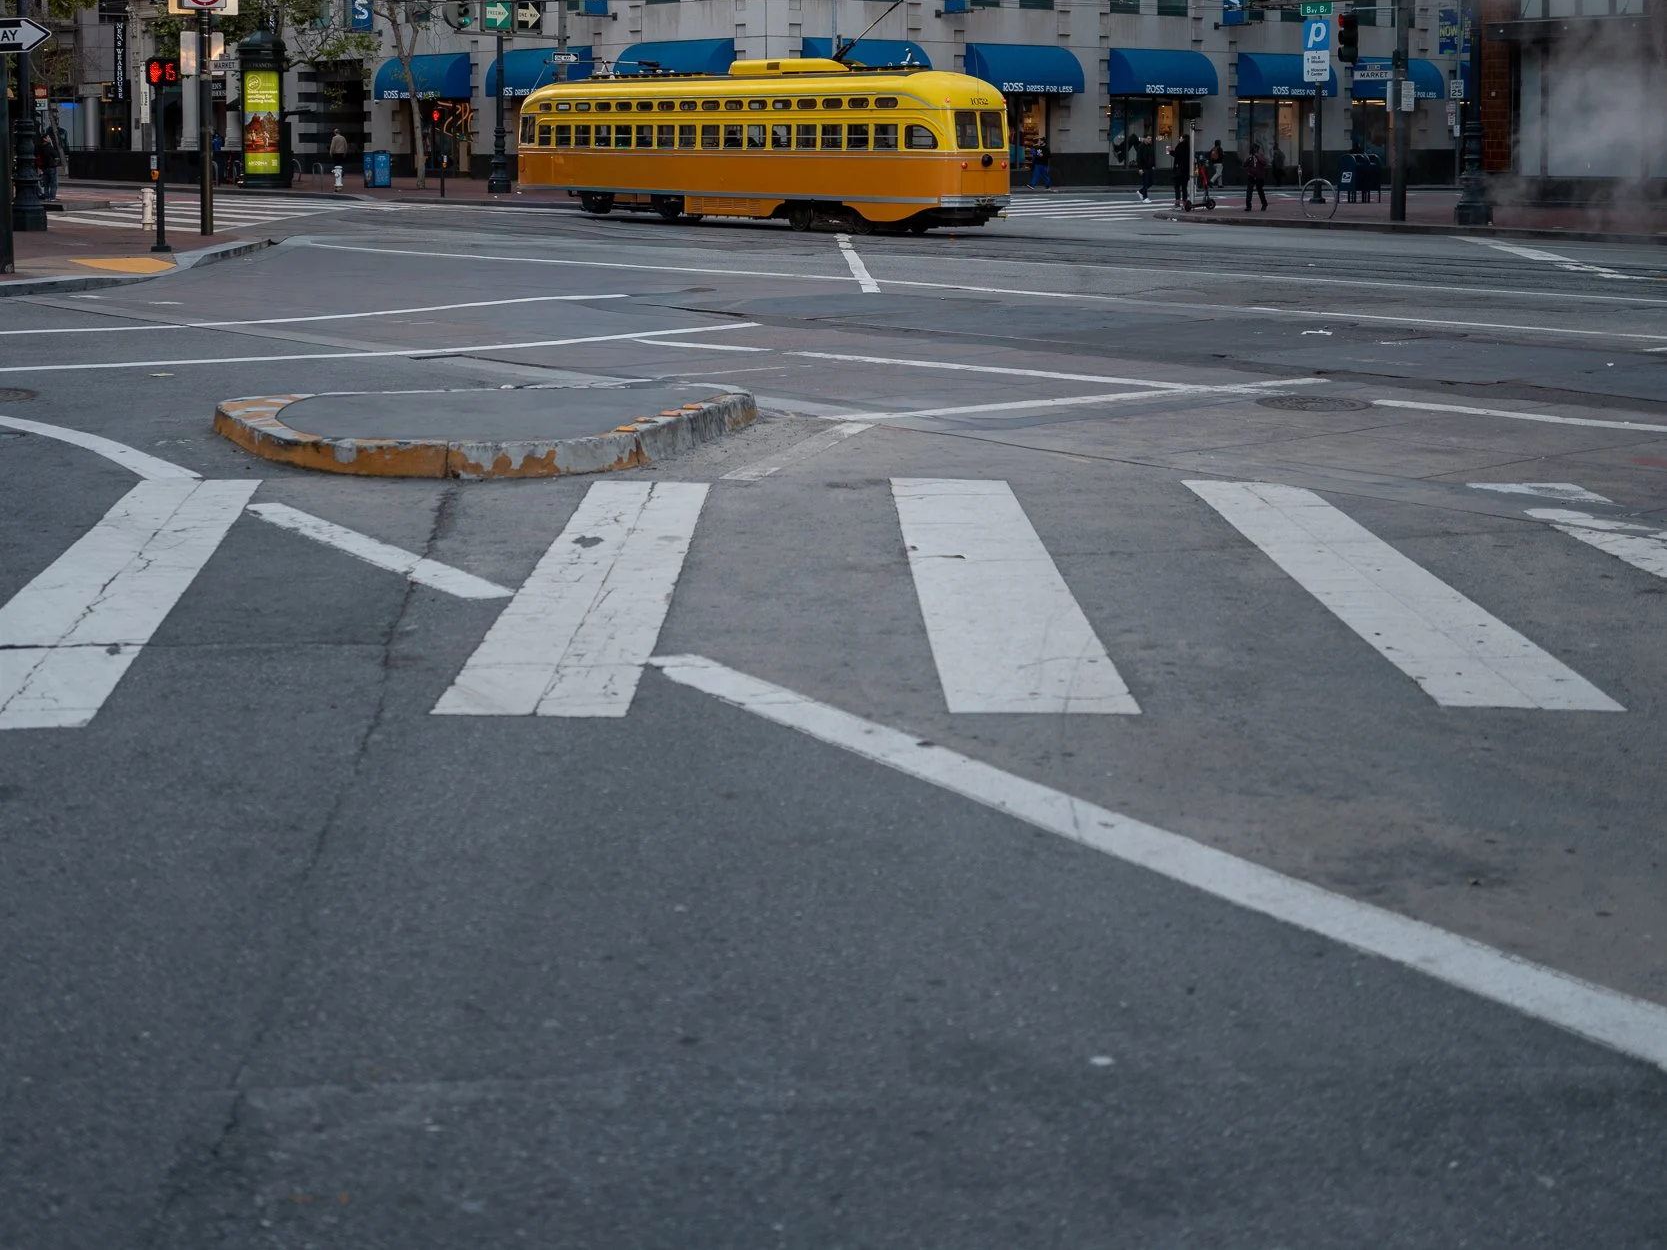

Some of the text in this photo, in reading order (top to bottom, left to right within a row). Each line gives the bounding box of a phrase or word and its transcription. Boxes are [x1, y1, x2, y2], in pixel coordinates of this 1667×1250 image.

[1306, 5, 1328, 14] Bay Br
[0, 29, 18, 42] AY
[213, 61, 235, 69] MARKET
[116, 48, 124, 99] WEARHOUSE
[165, 63, 177, 81] 6
[1360, 71, 1389, 79] MARKET
[1002, 82, 1024, 92] ROSS
[1145, 84, 1165, 94] ROSS
[1272, 86, 1290, 95] ROSS
[1290, 88, 1306, 96] DRESS
[383, 90, 399, 99] ROSS
[514, 88, 530, 96] DRESS
[1451, 89, 1463, 97] 25
[970, 97, 989, 106] 1052
